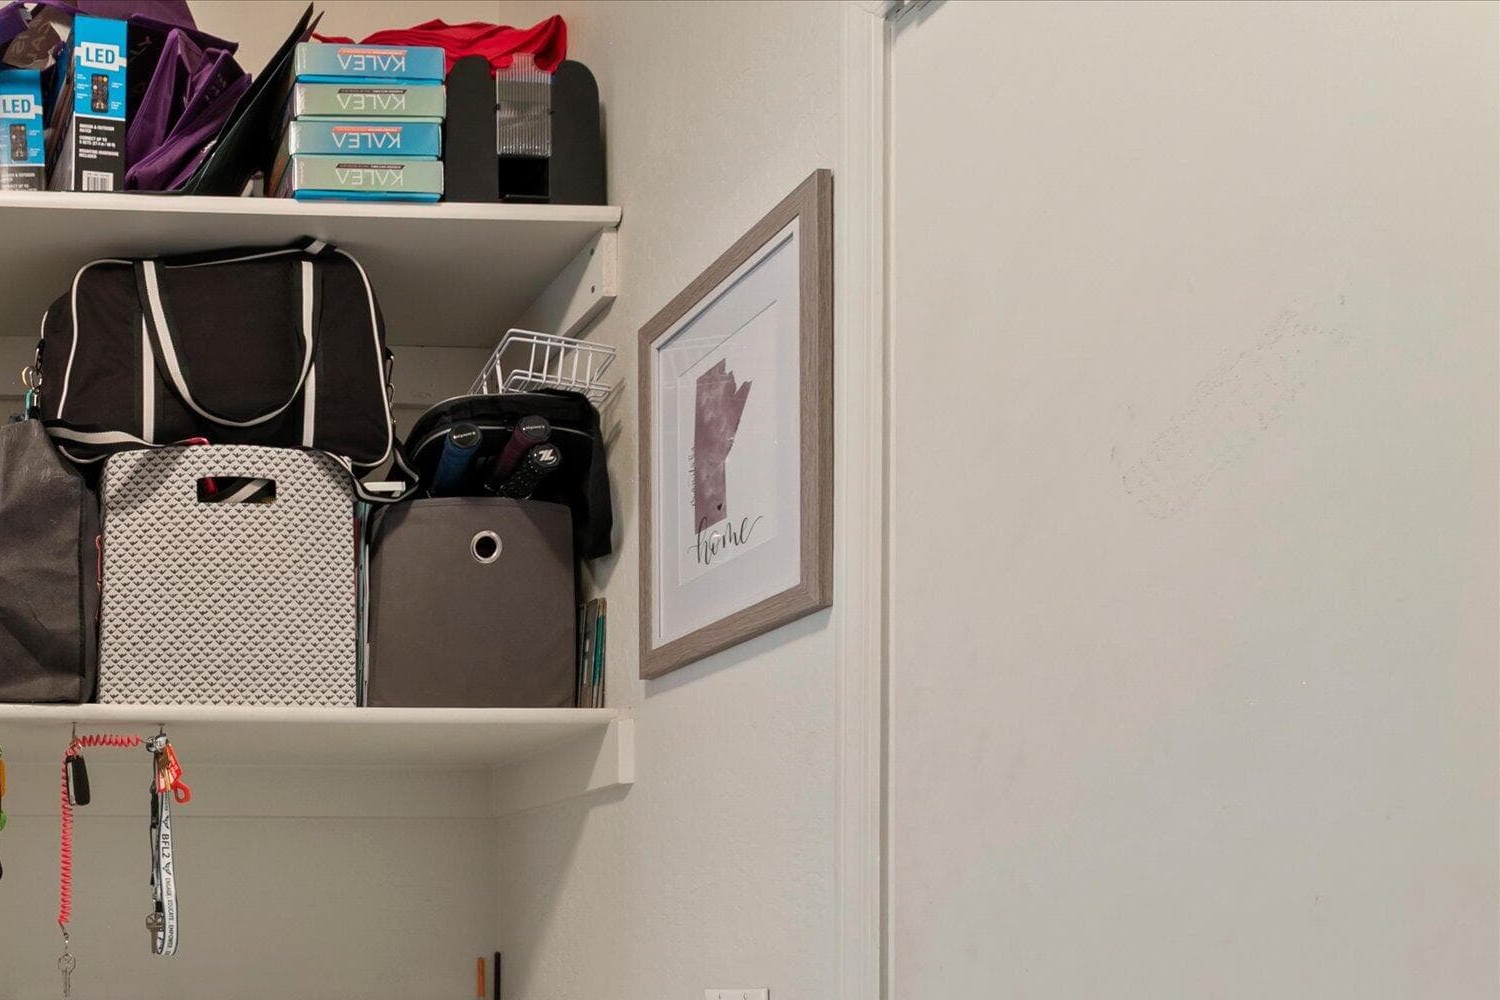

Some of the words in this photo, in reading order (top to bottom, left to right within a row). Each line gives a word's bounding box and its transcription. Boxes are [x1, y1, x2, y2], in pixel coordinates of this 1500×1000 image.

[85, 46, 116, 65] LED
[2, 99, 31, 114] LED
[687, 515, 763, 565] home
[161, 833, 171, 859] BFL2
